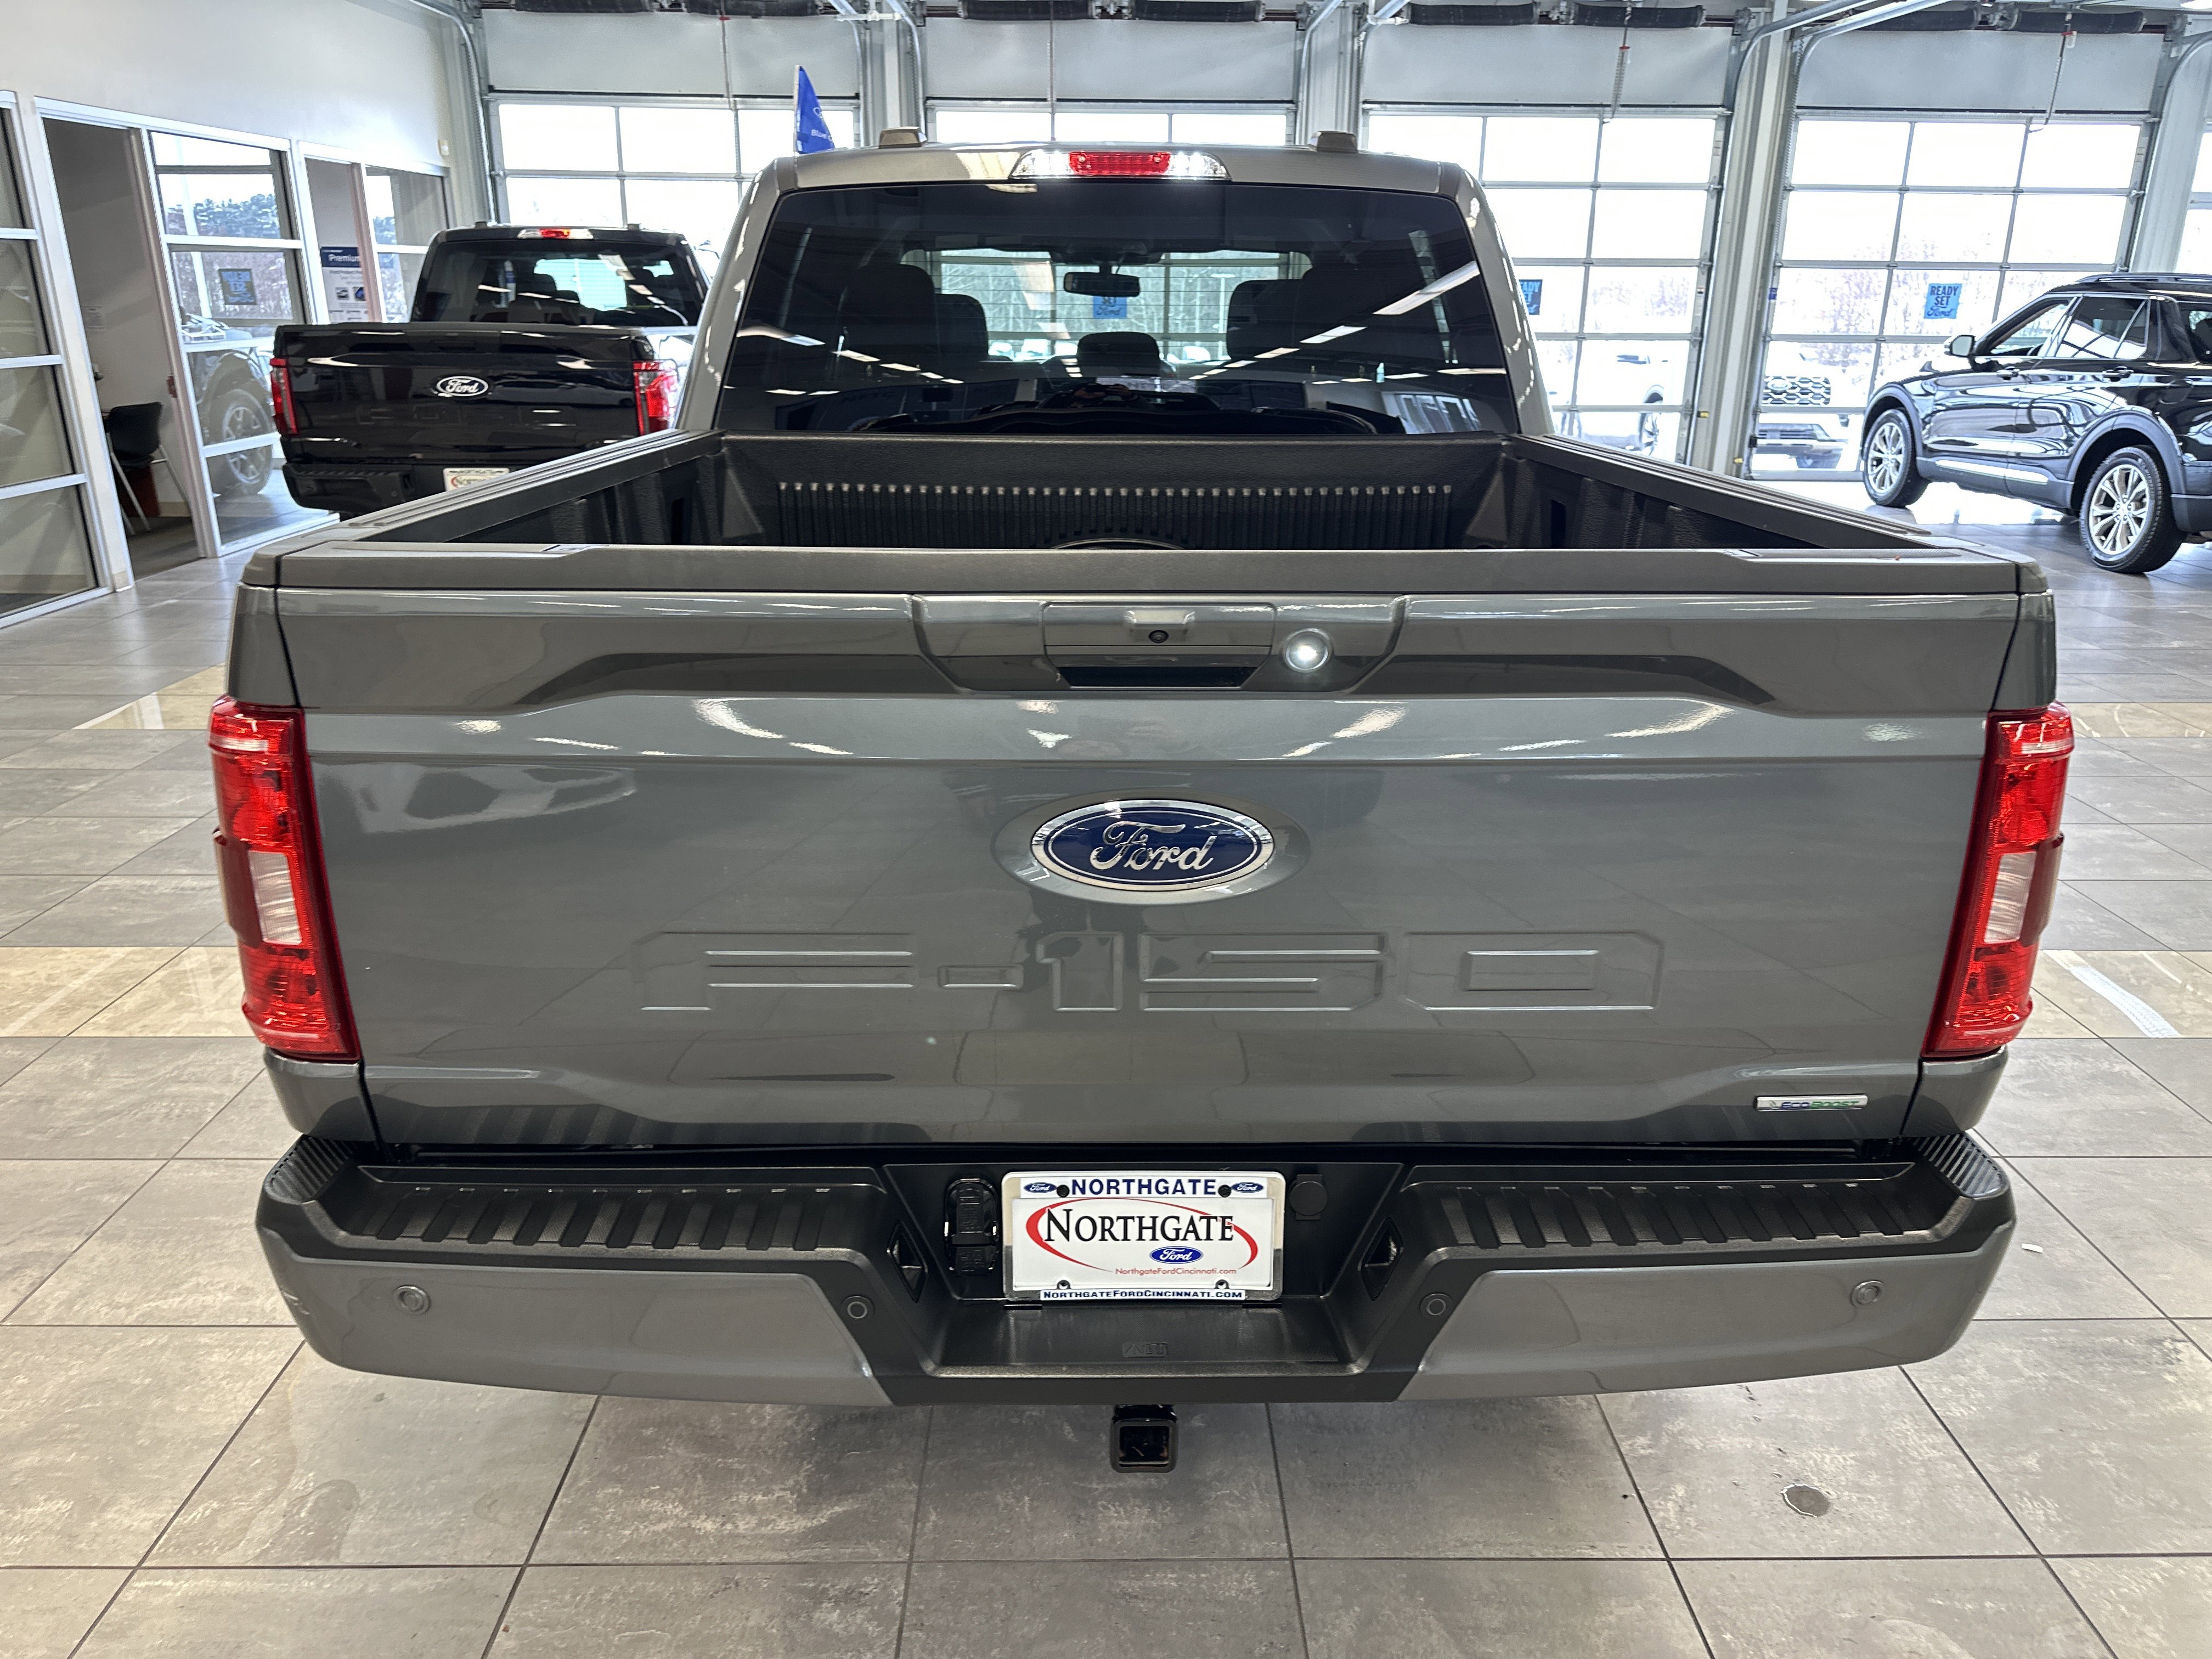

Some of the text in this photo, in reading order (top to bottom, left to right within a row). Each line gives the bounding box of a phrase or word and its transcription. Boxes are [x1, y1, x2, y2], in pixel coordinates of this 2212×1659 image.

[1930, 286, 1959, 296] READY
[1934, 296, 1951, 306] SET
[1927, 306, 1955, 317] Ford
[445, 379, 479, 392] Ford
[1089, 821, 1217, 870] Ford
[639, 930, 1664, 1011] F-150
[1071, 1178, 1216, 1195] NORTHGATE
[1159, 1248, 1193, 1261] Ford
[1115, 1267, 1237, 1276] NorthgateFordCincinnati.com
